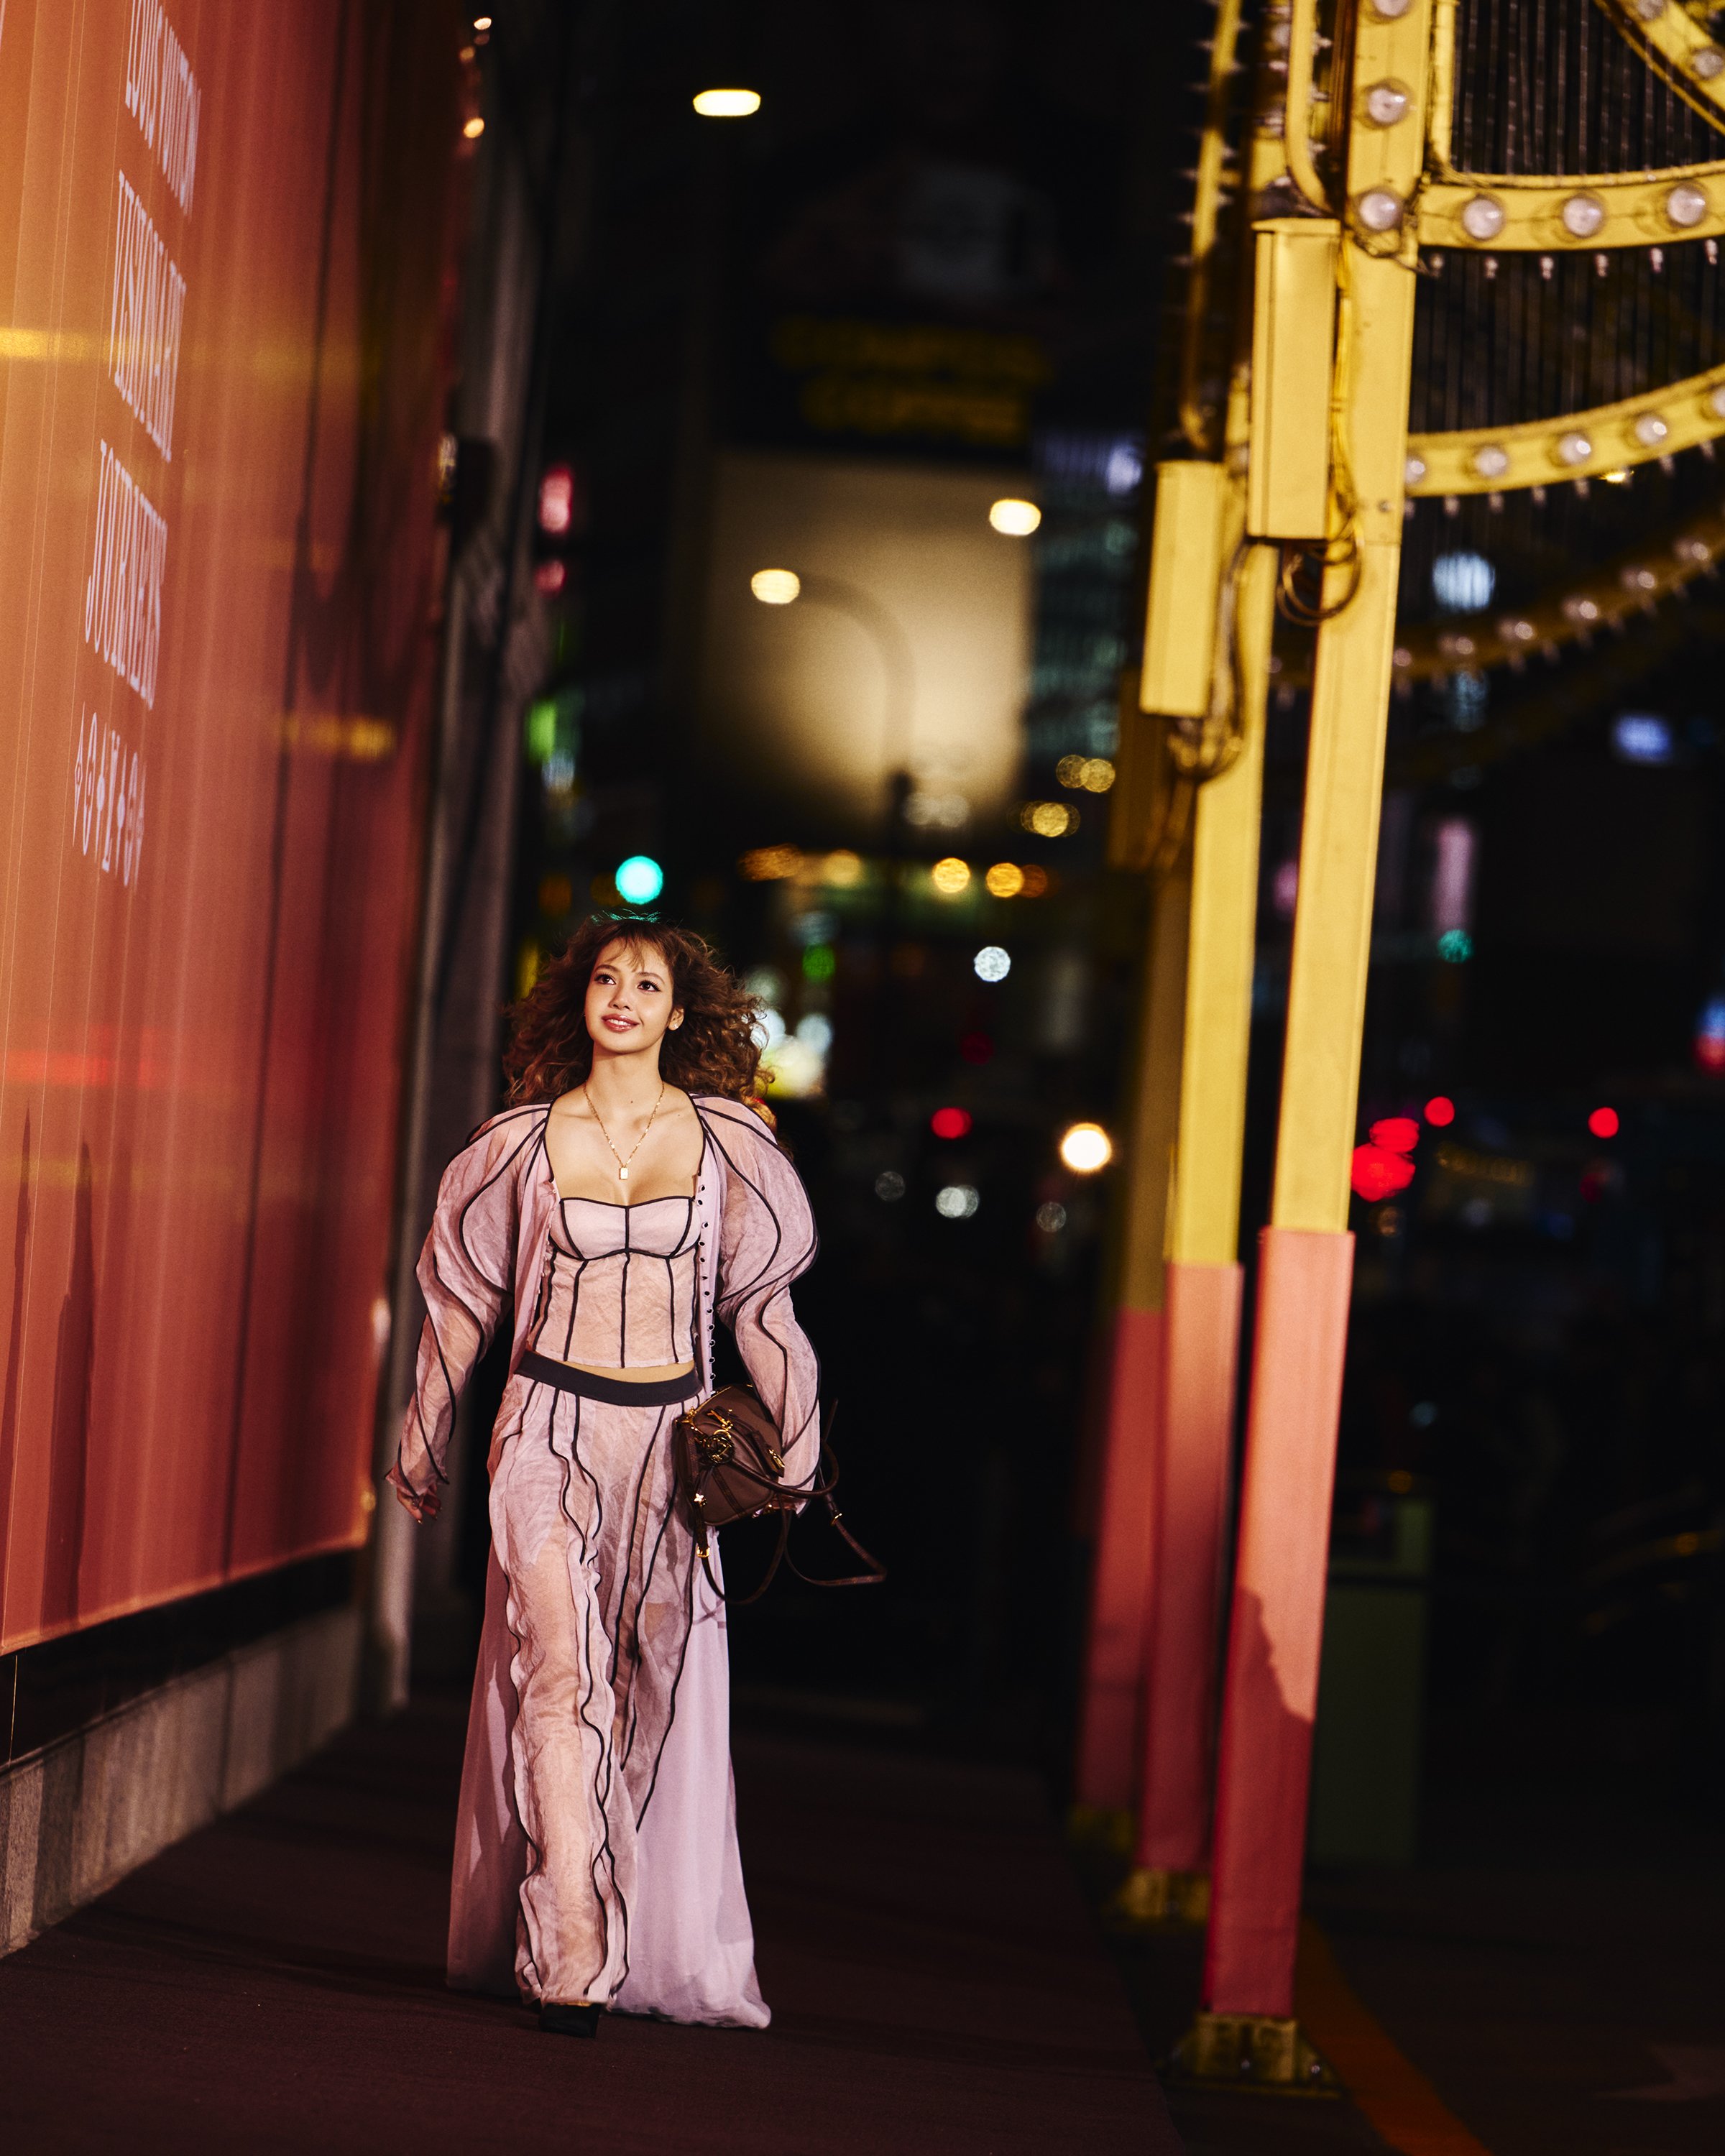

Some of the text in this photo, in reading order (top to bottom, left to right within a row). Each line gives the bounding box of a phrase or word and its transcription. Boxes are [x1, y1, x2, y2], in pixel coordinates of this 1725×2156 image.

[125, 0, 201, 224] LOUIS VUITTON
[109, 170, 186, 464] VISIONARY
[85, 439, 167, 711] JOURNEYS
